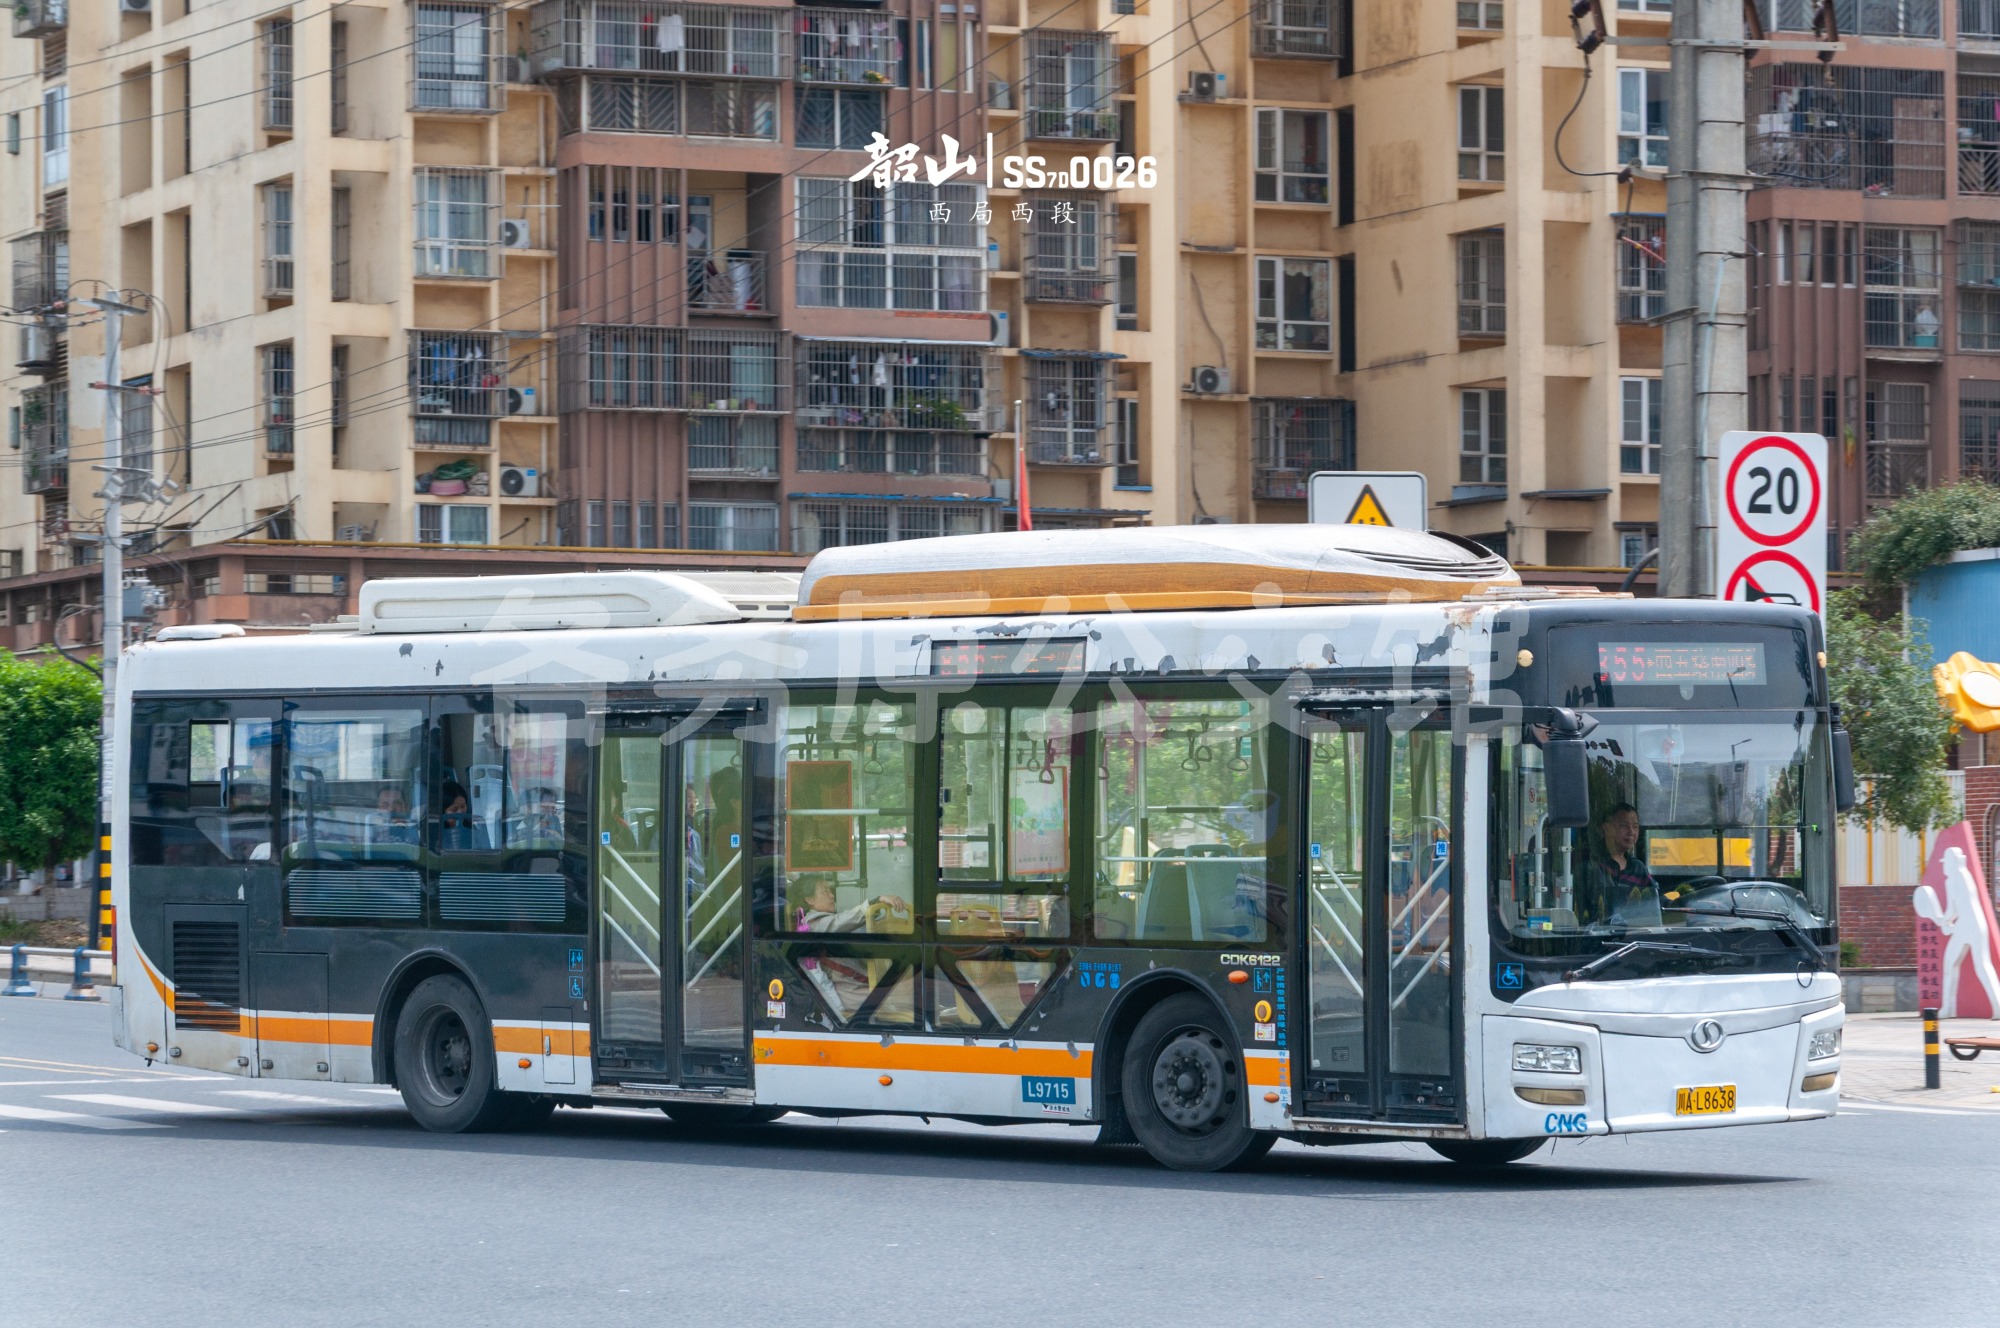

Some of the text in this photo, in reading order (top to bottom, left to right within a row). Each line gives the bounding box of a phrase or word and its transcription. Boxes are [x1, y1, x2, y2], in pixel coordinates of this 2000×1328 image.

[1747, 466, 1799, 515] 20
[1220, 954, 1281, 966] CDK6122
[1028, 1081, 1069, 1099] L9715
[1545, 1113, 1588, 1134] CNG
